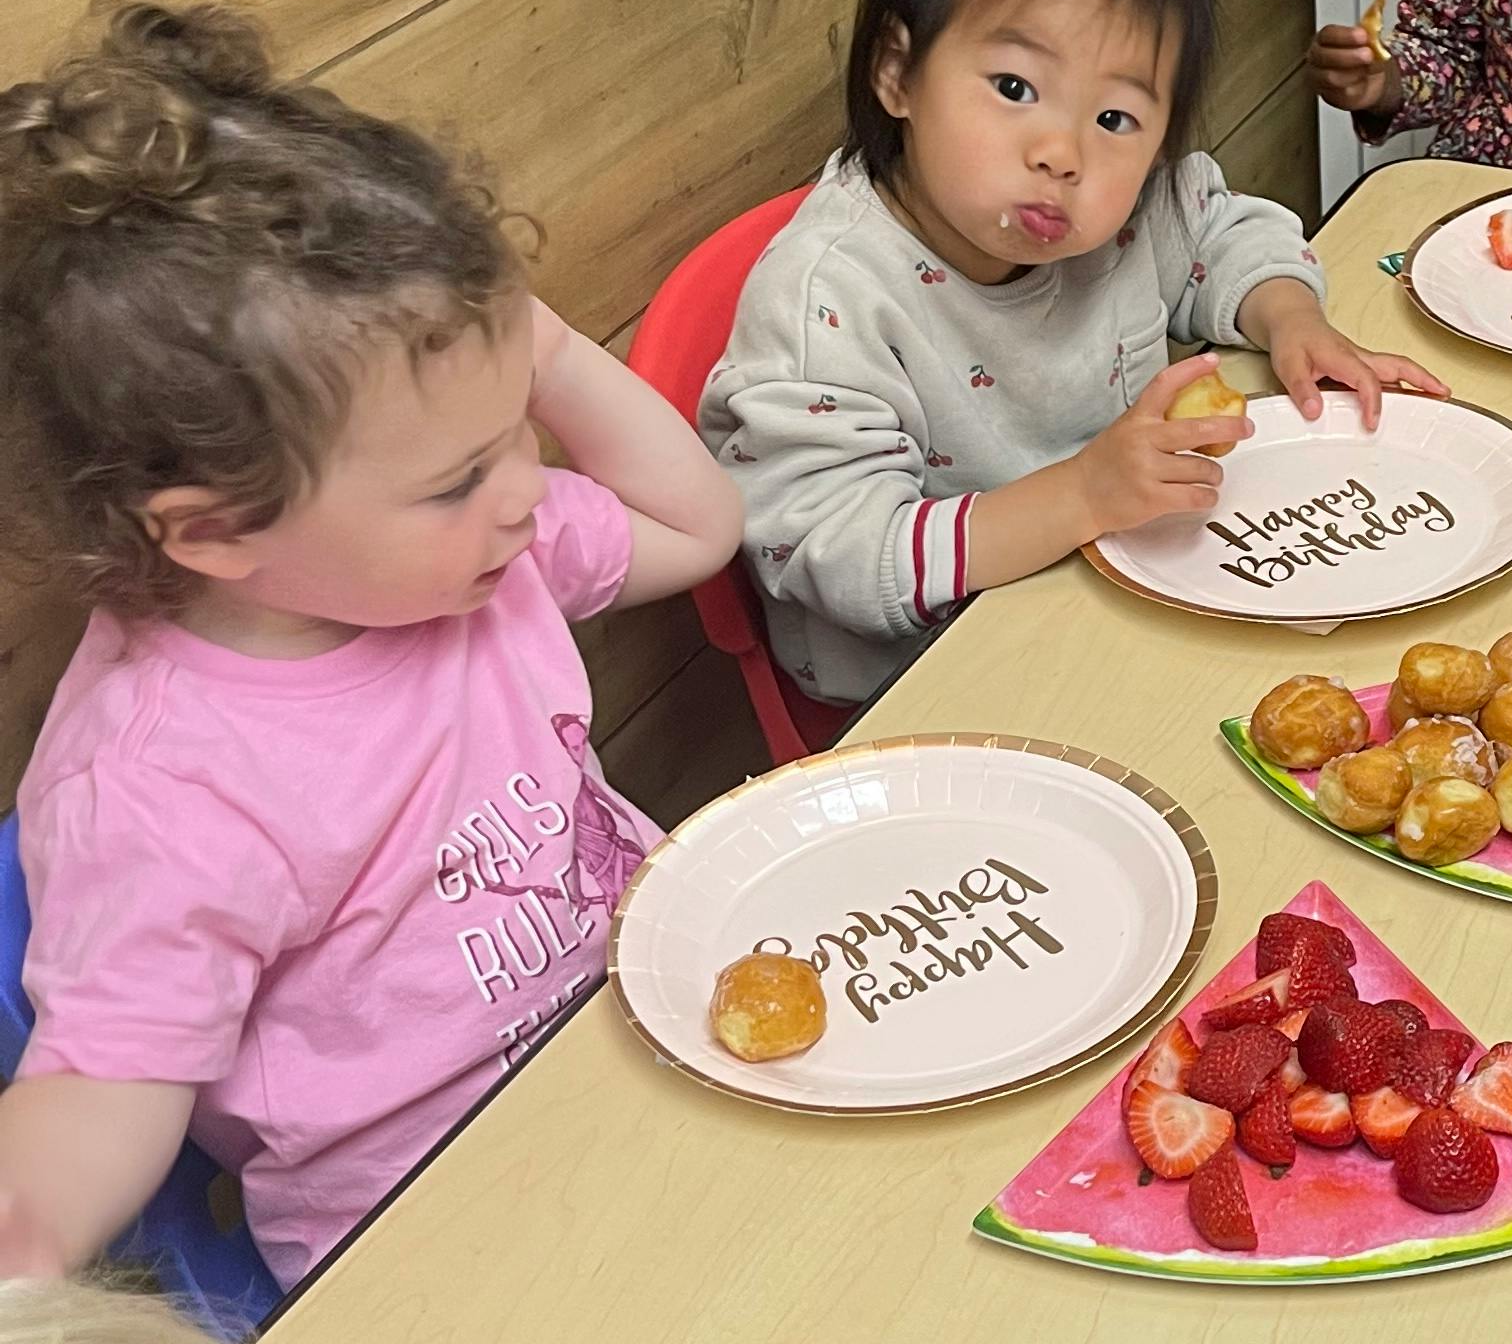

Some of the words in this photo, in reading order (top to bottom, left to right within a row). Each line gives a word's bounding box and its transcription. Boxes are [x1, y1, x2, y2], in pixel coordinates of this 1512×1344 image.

[1205, 478, 1378, 553] Happy
[1218, 490, 1456, 588] Birthday
[434, 772, 568, 902] GIRLS
[457, 862, 596, 1004] RULE
[844, 909, 1065, 1024] Happy
